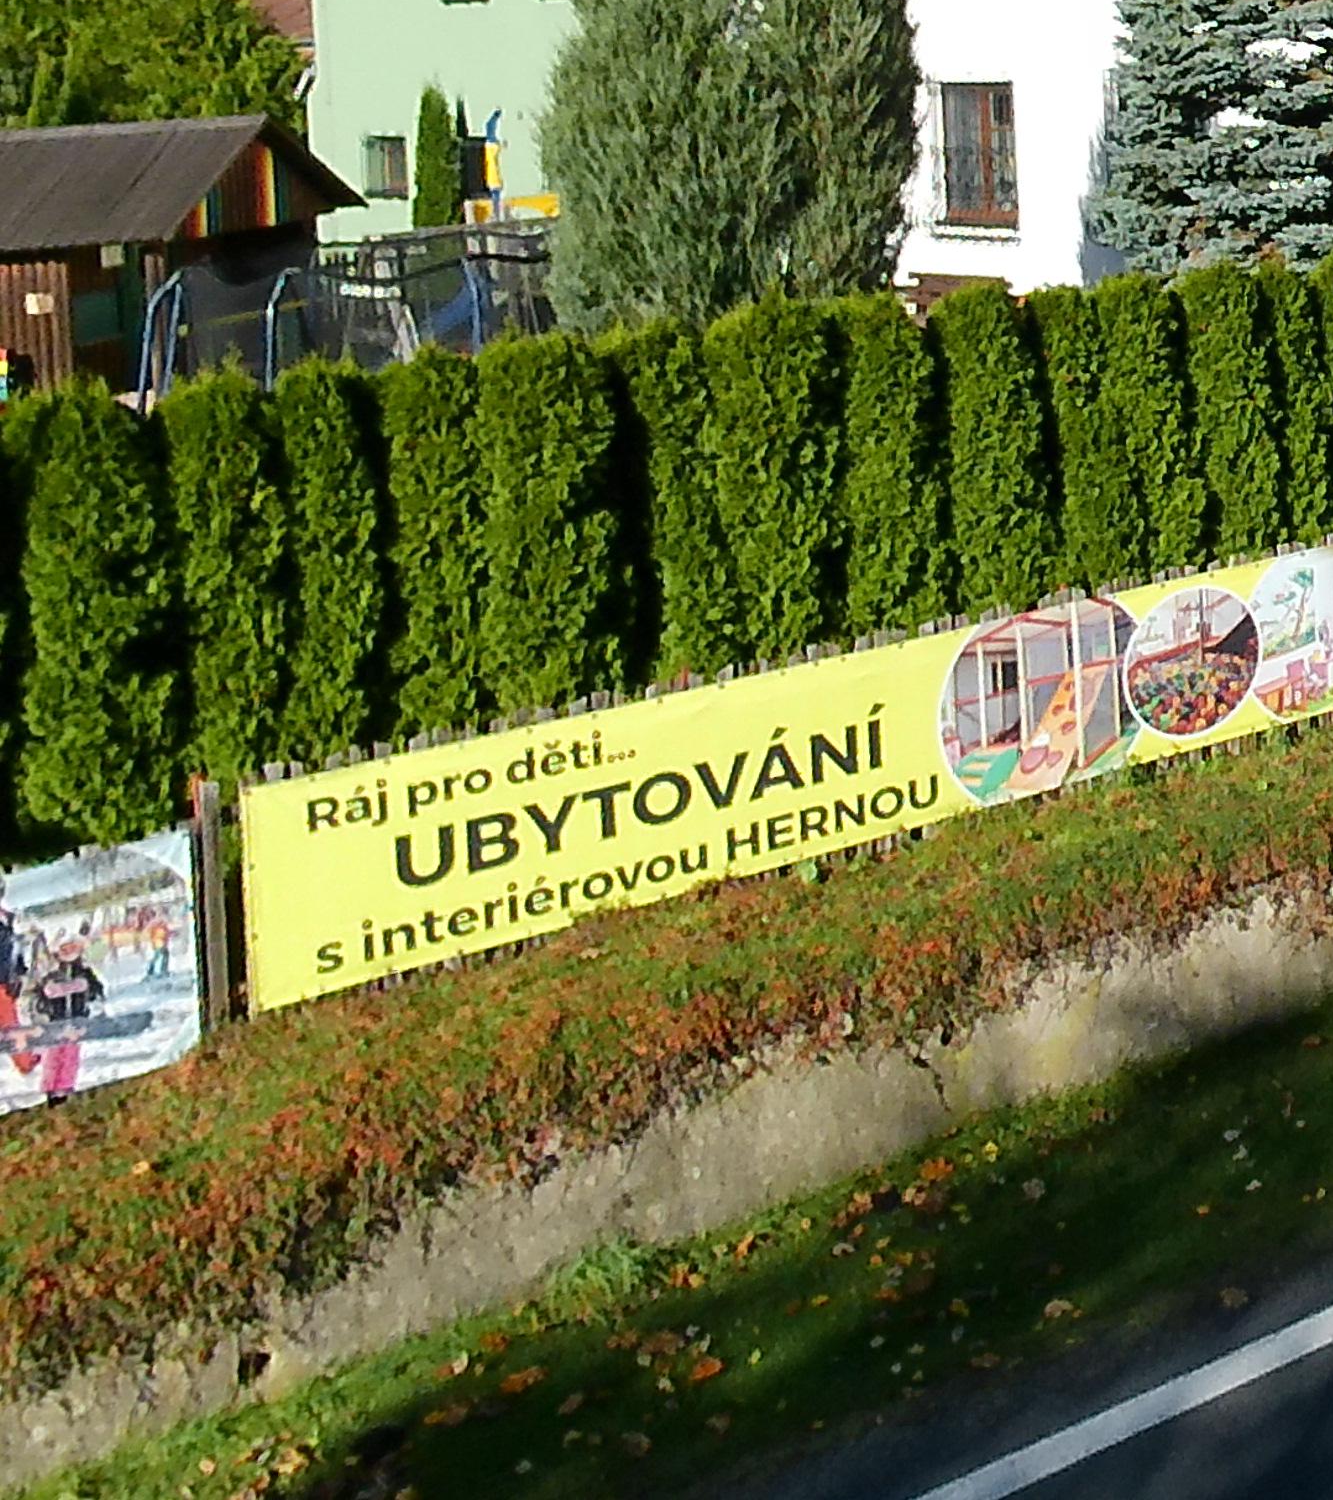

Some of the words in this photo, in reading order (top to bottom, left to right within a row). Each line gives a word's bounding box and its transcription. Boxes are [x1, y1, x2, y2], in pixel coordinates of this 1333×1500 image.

[307, 778, 388, 833] Ráj
[407, 768, 493, 818] pro
[506, 730, 637, 785] děti...
[394, 703, 886, 888] UBYTOVÁNÍ
[316, 941, 344, 975] s
[361, 843, 709, 963] interiérovou
[726, 774, 939, 862] HERNOU
